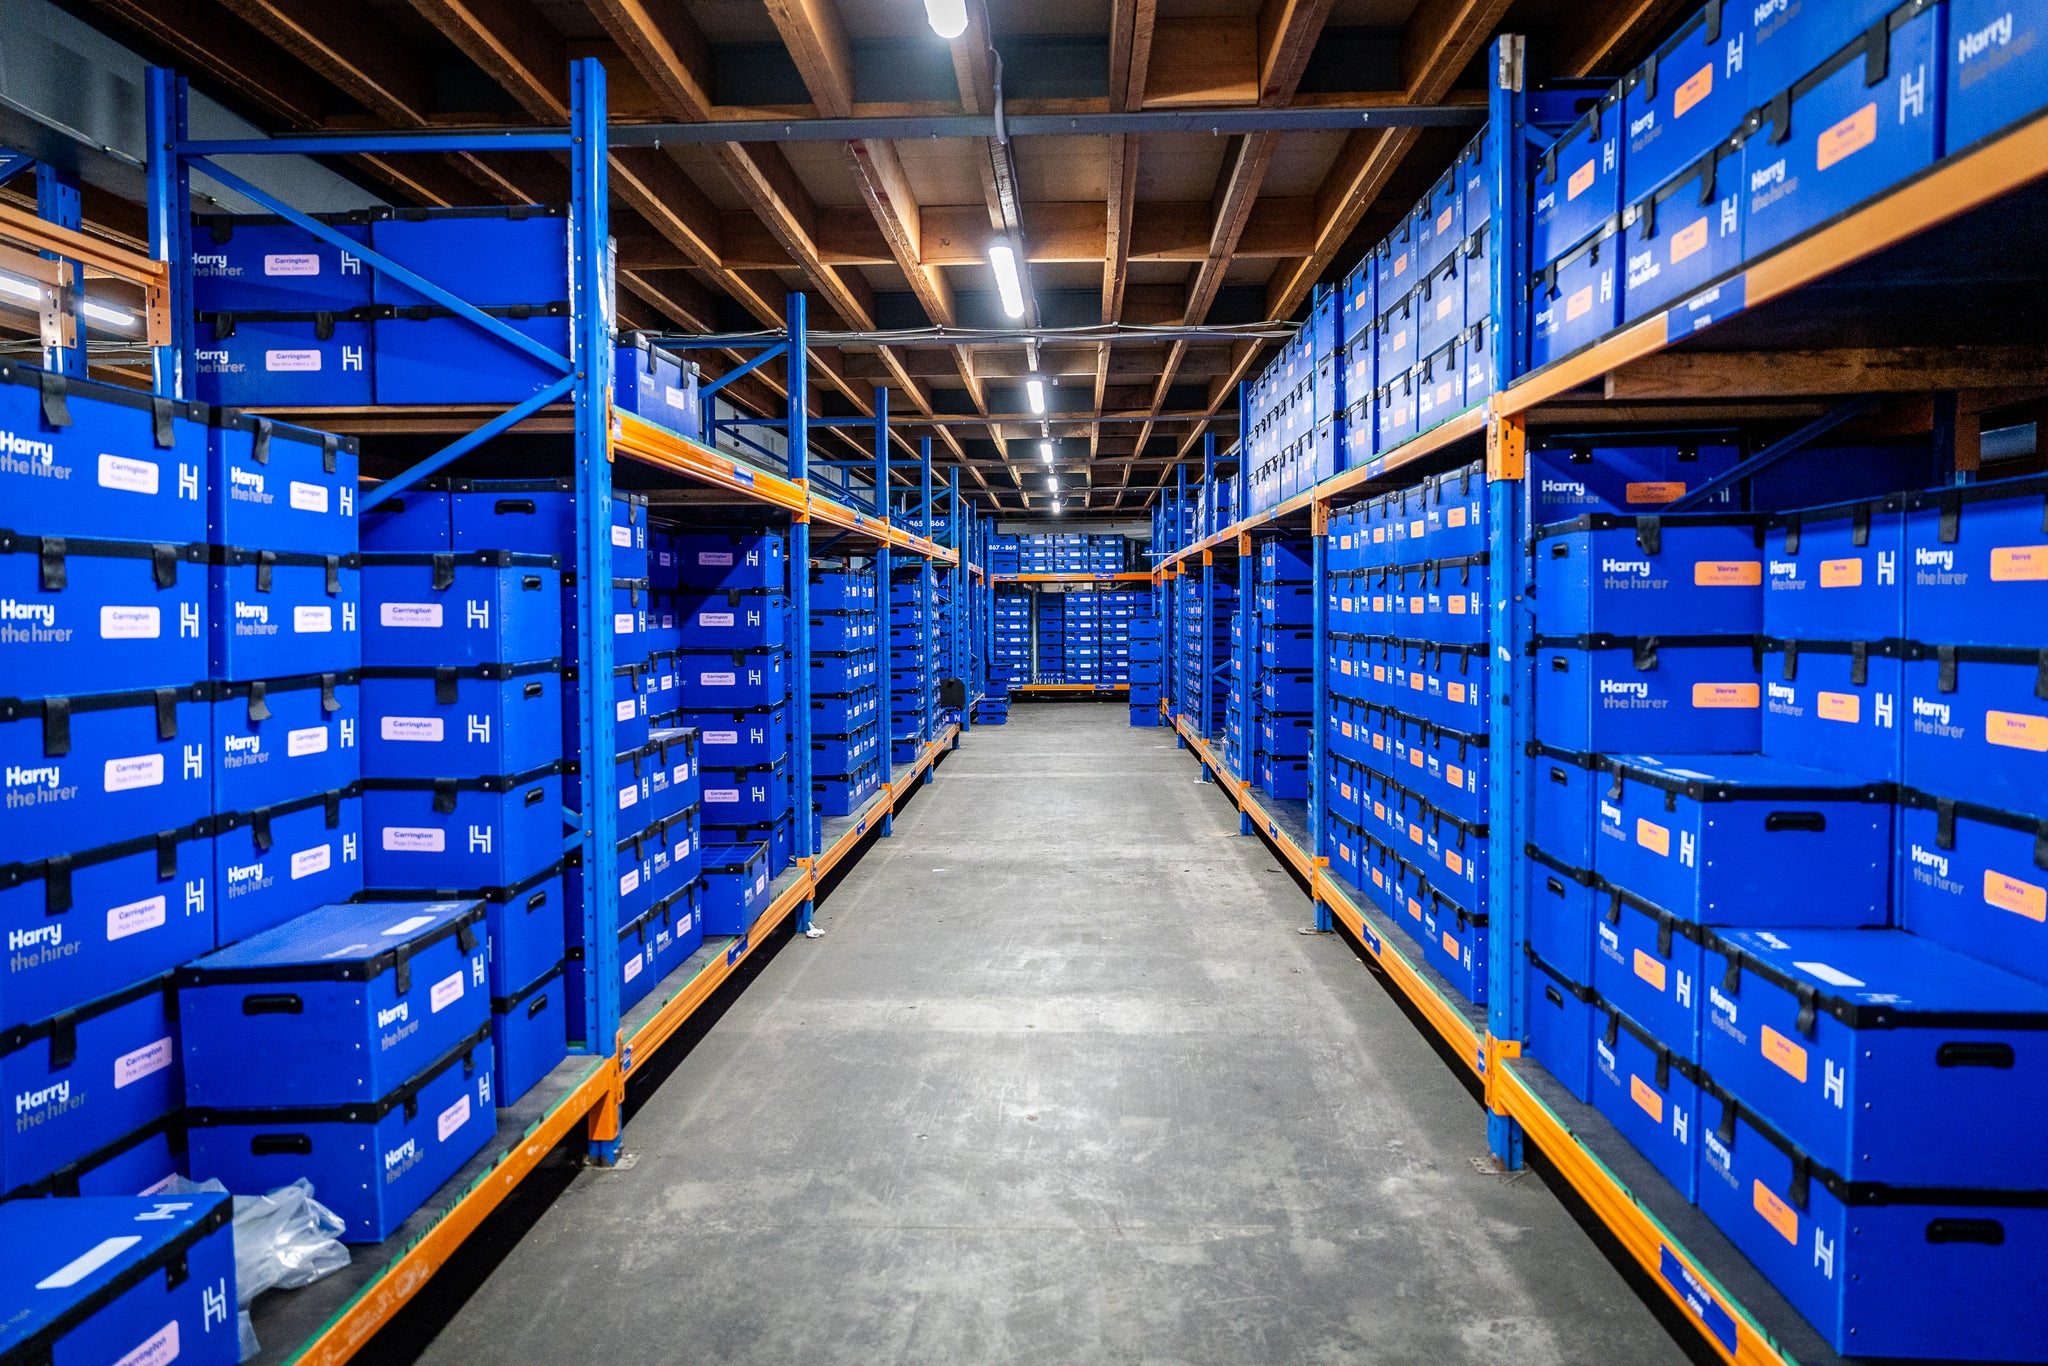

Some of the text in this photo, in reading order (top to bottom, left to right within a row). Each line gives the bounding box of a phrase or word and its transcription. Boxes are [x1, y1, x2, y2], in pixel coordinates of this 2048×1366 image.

[1958, 12, 2013, 64] Harry
[1751, 158, 1786, 192] Harry
[0, 430, 53, 465] Harry
[231, 466, 264, 492] Harry
[1542, 480, 1585, 496] Harry
[1602, 558, 1650, 577] Harry
[1770, 560, 1796, 579] Harry
[1916, 547, 1953, 570] Harry
[0, 599, 55, 627] Harry
[235, 601, 268, 624] Harry
[392, 606, 432, 615] Carrington
[1600, 679, 1648, 698] Harry
[1768, 682, 1794, 704] Harry
[1913, 696, 1950, 725] Harry
[393, 720, 433, 730] Carrington
[224, 735, 260, 754] Harry
[6, 765, 60, 788] Harry
[394, 831, 433, 840] Carrington
[1912, 844, 1948, 878] Harry
[228, 863, 263, 883] Harry
[9, 923, 62, 951] Harry
[378, 1002, 408, 1028] Harry
[16, 1080, 69, 1114] Harry
